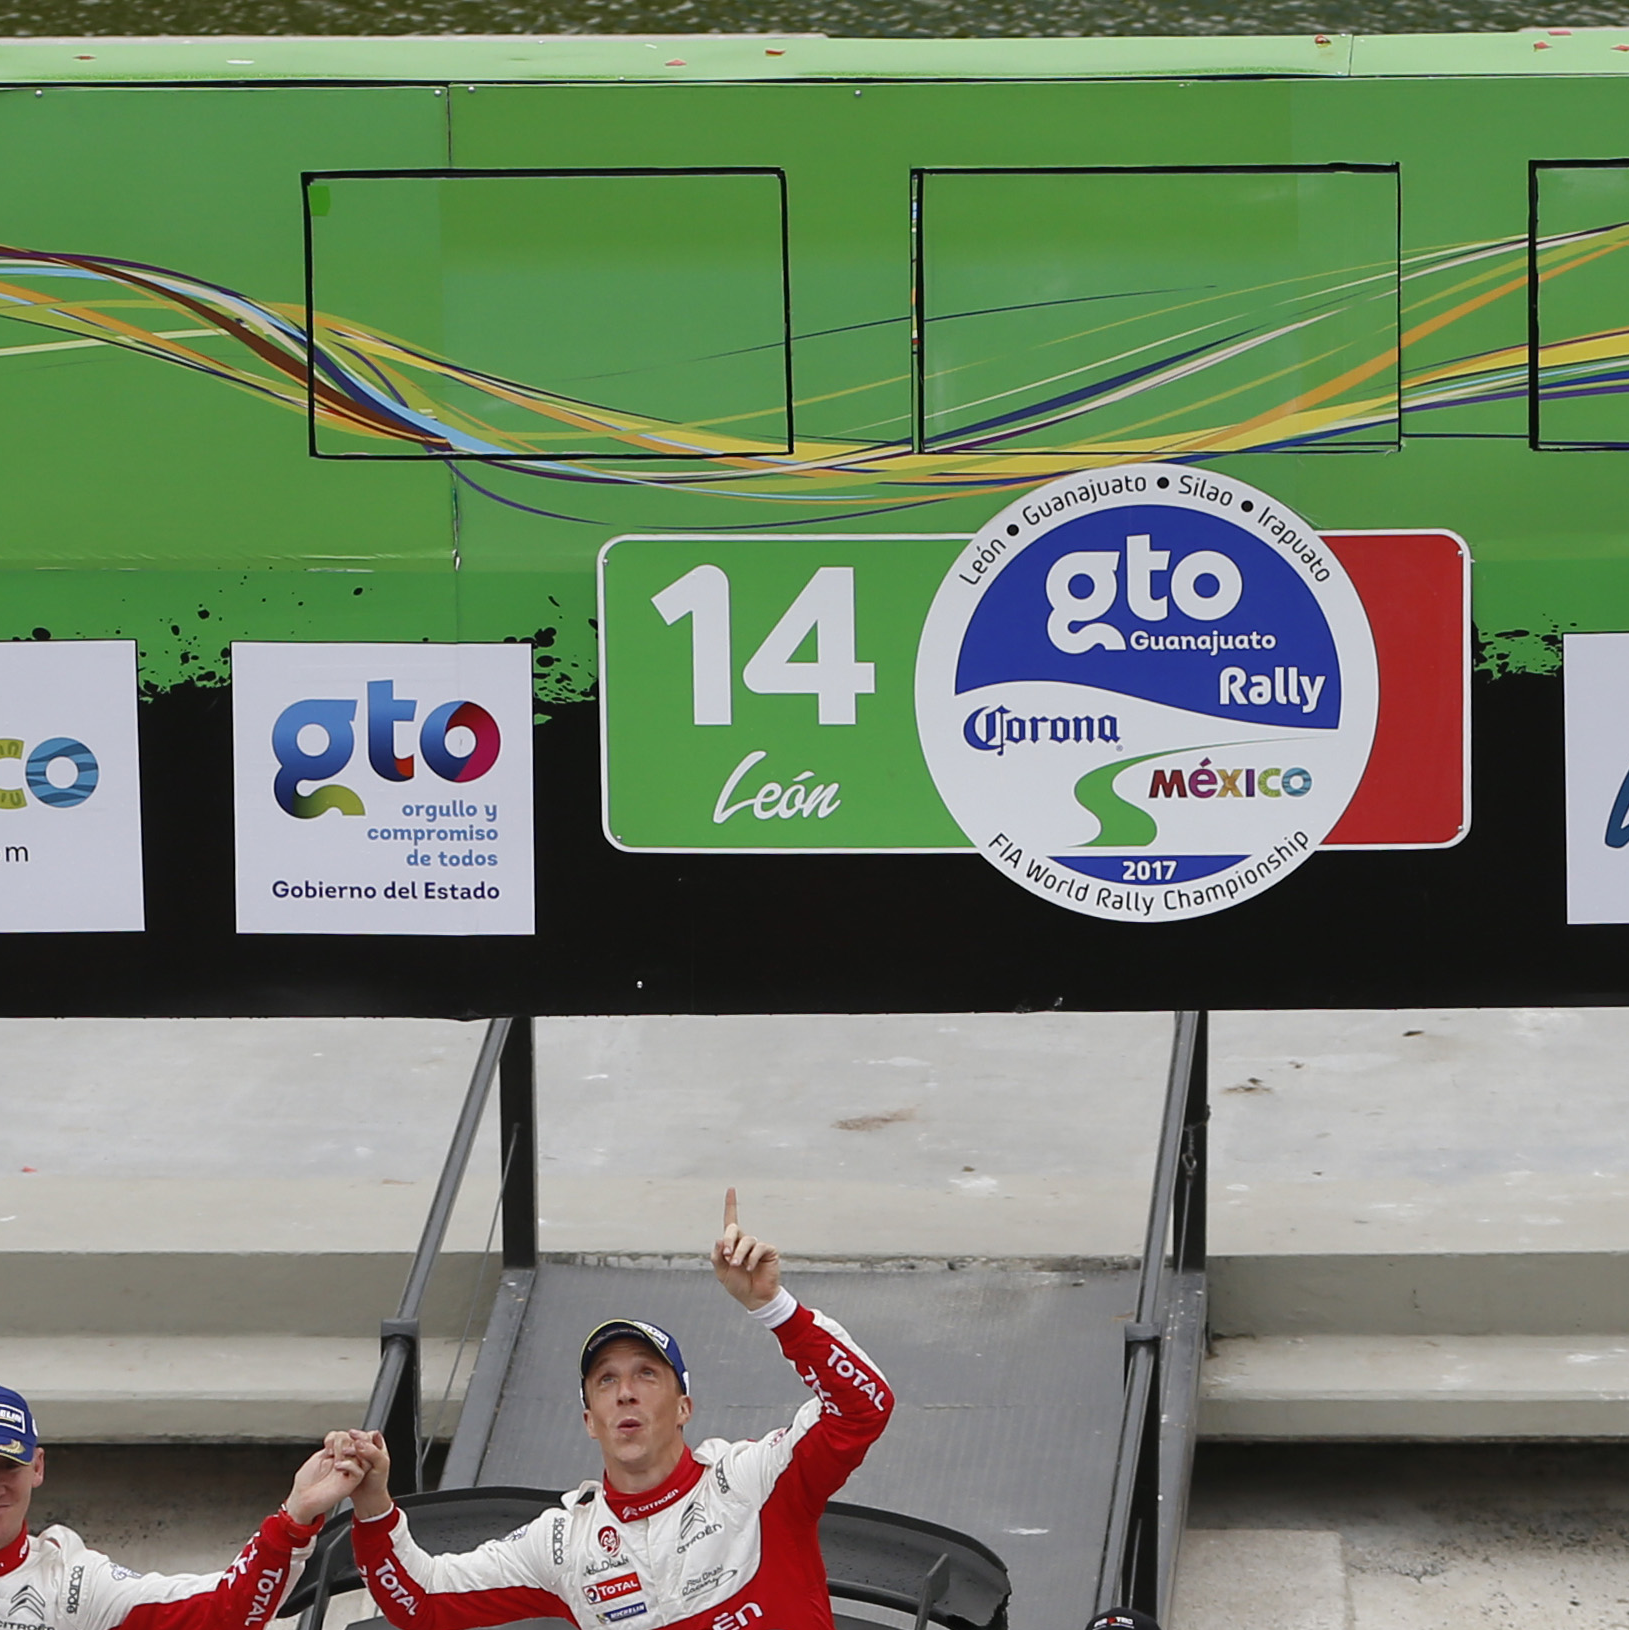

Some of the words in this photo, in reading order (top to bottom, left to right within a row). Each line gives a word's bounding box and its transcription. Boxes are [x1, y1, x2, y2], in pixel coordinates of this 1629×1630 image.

[959, 534, 1007, 587] León
[1021, 473, 1148, 528] Guanajuato
[1178, 474, 1235, 507] Silao
[1257, 505, 1333, 584] Irapuato
[1046, 533, 1244, 655] gto
[650, 564, 877, 726] 14
[1130, 630, 1278, 656] Guanajuato
[1219, 666, 1327, 714] Rally
[272, 679, 502, 820] gto
[962, 704, 1122, 756] Corona
[402, 801, 479, 823] orgullo
[484, 804, 498, 823] y
[712, 750, 842, 825] León
[367, 824, 499, 846] compromiso
[406, 848, 432, 867] de
[438, 848, 499, 867] todos
[271, 880, 377, 901] Gobierno
[384, 880, 419, 901] del
[424, 881, 501, 902] Estado
[987, 832, 1021, 868] FIA
[1020, 859, 1091, 906] World
[1095, 887, 1156, 917] Rally
[1161, 829, 1311, 912] Championship
[1122, 860, 1177, 882] 2017
[826, 1343, 886, 1412] TOTAL
[243, 1567, 284, 1627] TOTAL
[374, 1557, 420, 1617] TOTAL
[598, 1578, 639, 1596] TOTAL
